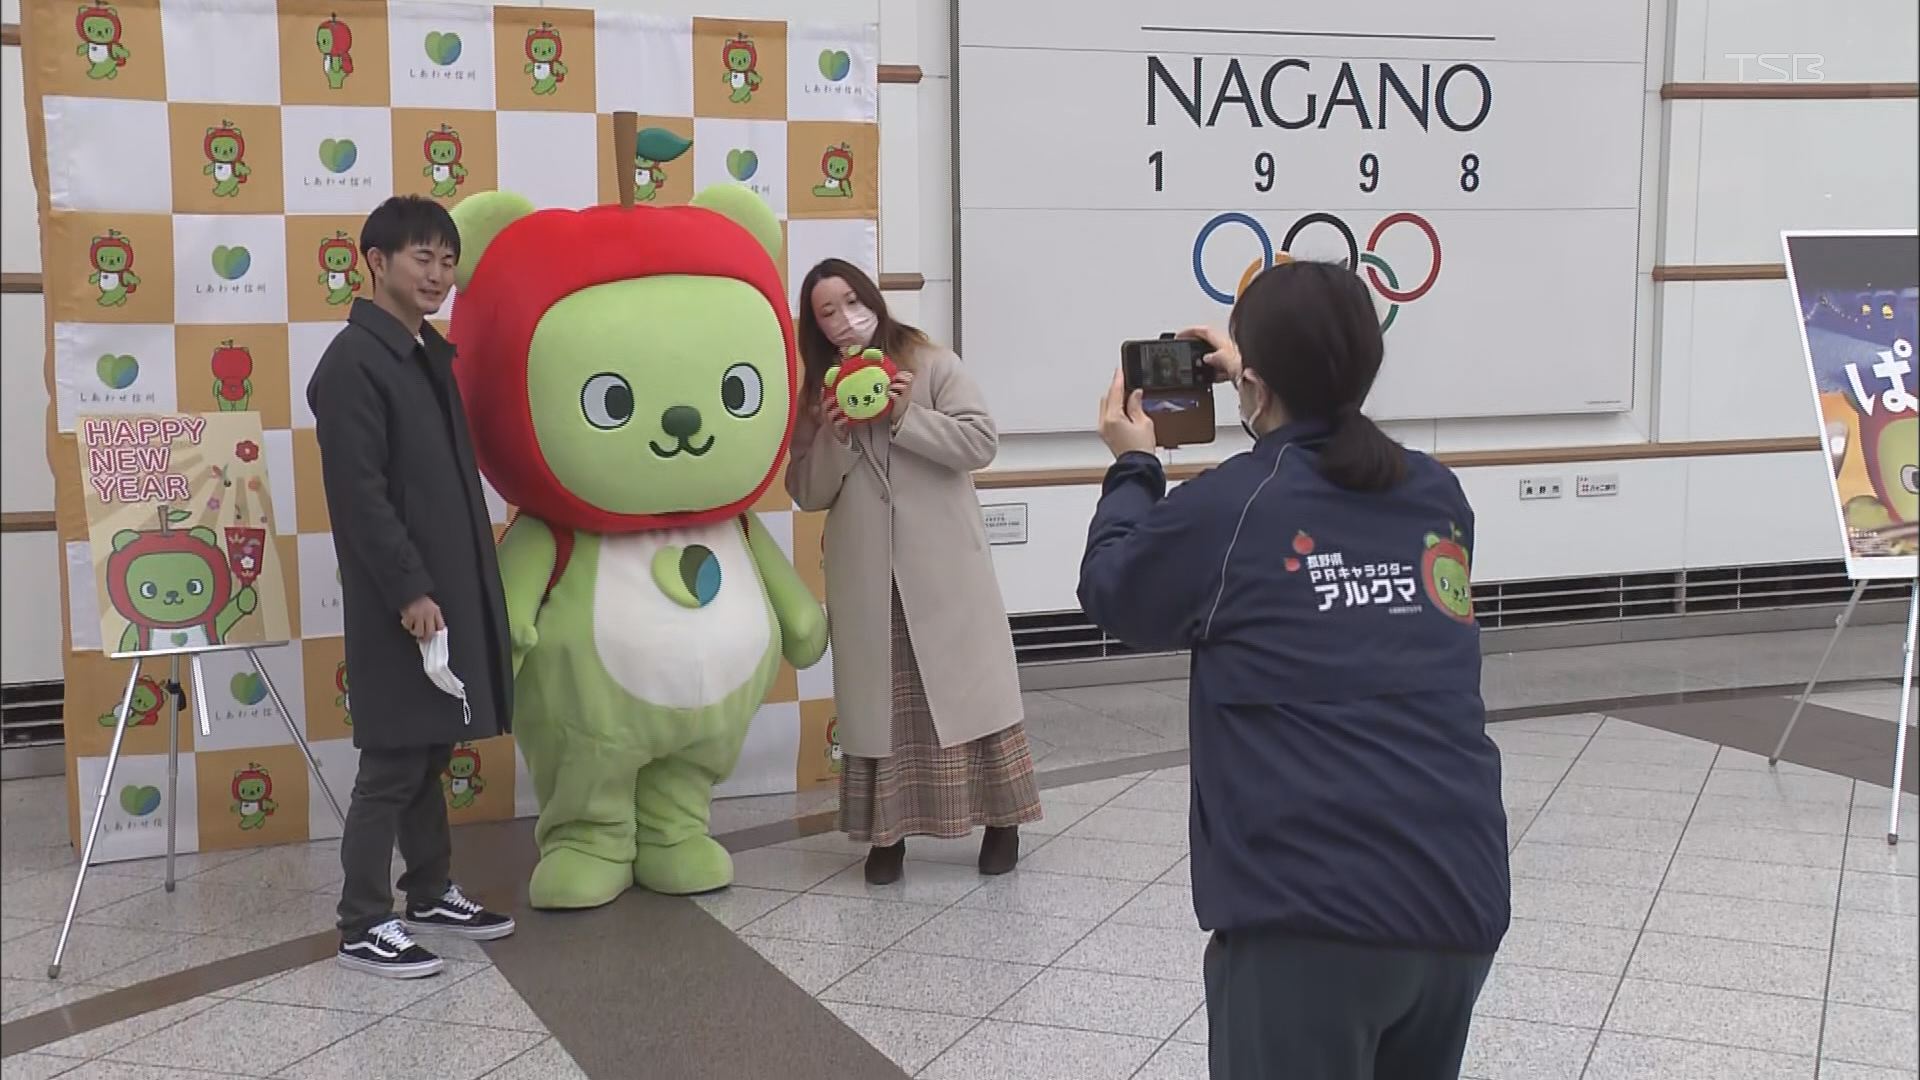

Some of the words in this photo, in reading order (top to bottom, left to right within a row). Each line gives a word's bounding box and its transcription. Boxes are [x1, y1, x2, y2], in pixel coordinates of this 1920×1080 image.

[409, 68, 476, 81] しあわせ信州
[1146, 55, 1492, 133] NAGANO
[303, 176, 372, 187] しあわせ信州
[1254, 152, 1275, 192] 9
[1359, 153, 1379, 193] 9
[1460, 153, 1480, 192] 8
[195, 283, 266, 294] しあわせ信州
[80, 392, 155, 403] しあわせ信州
[85, 417, 206, 446] HAPPY
[88, 446, 170, 476] NEW
[91, 474, 191, 503] YEAR
[1306, 552, 1344, 569] 長野県
[1310, 562, 1414, 583] PRキャラクター
[1314, 577, 1416, 611] アルクマ
[215, 707, 281, 720] しあわせ信
